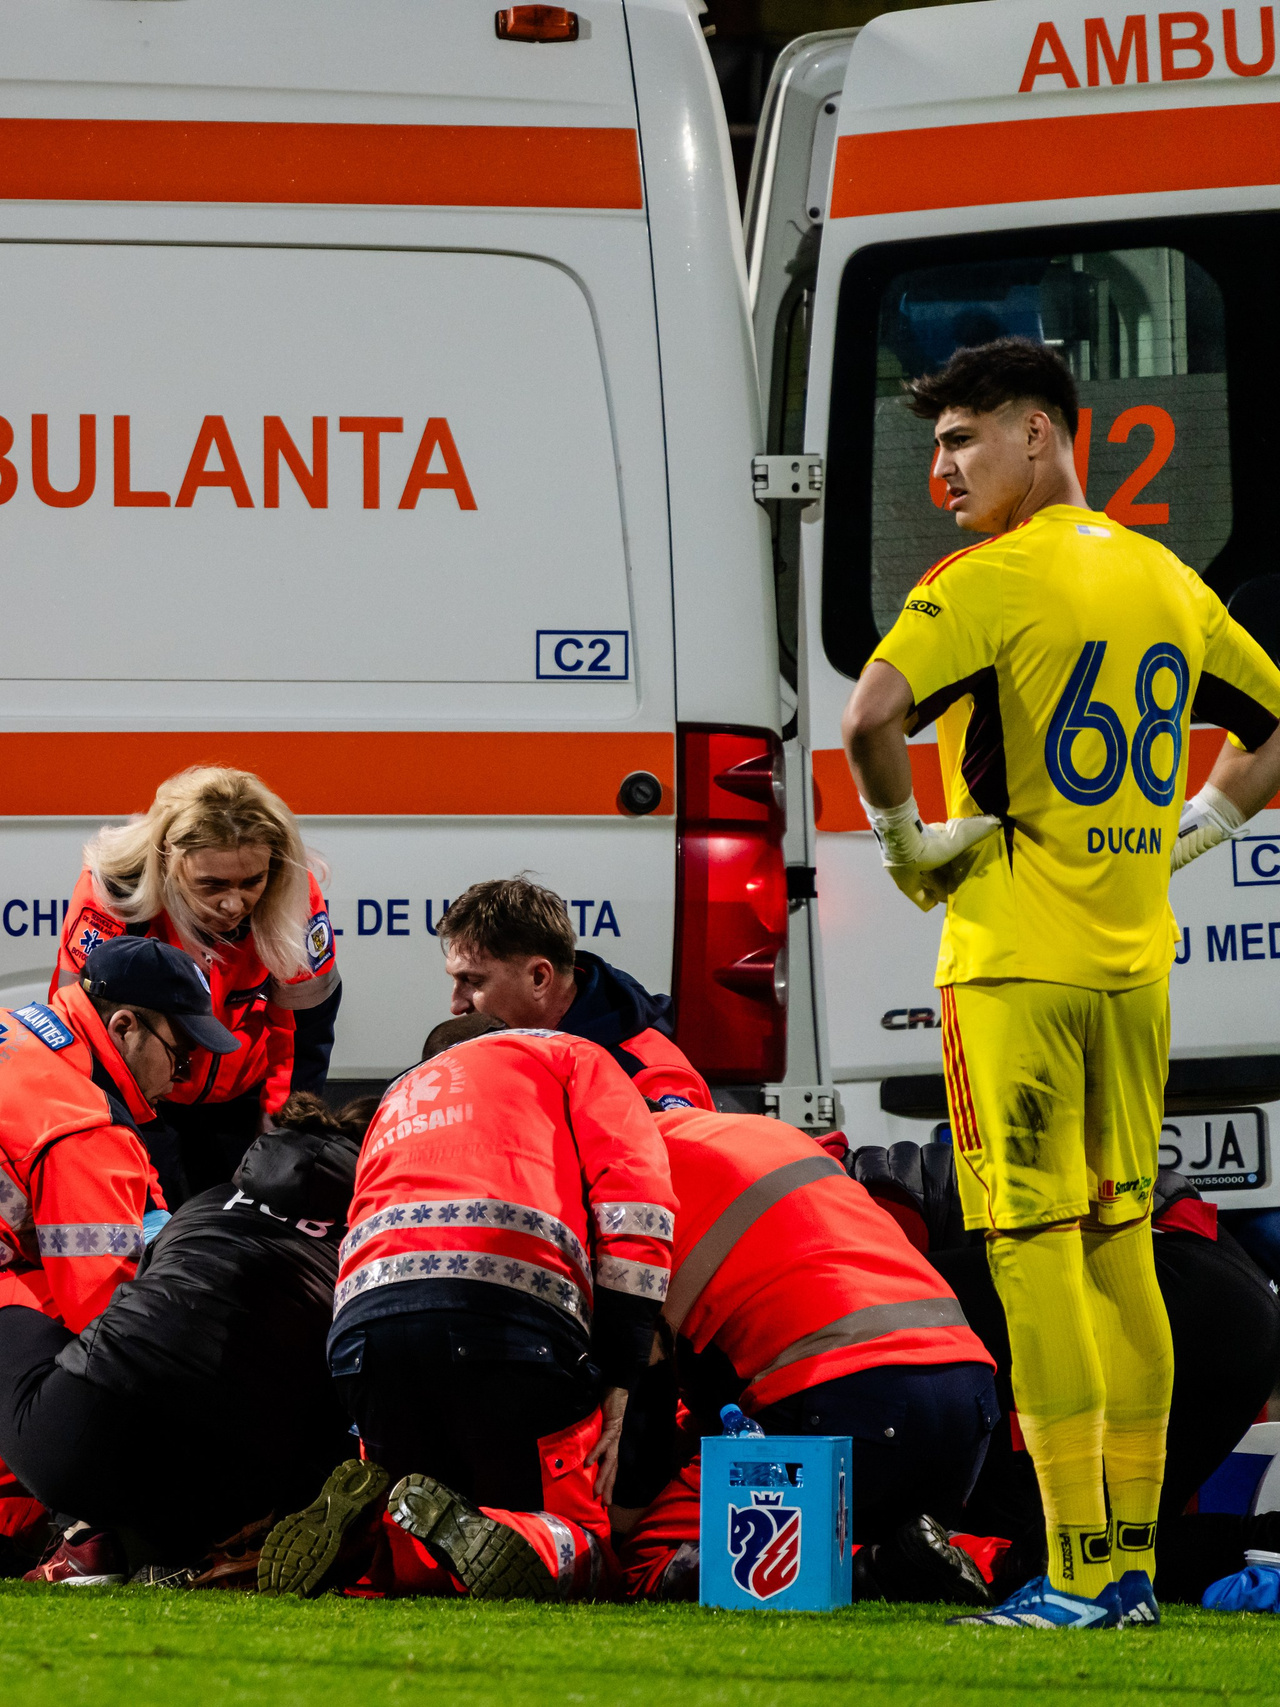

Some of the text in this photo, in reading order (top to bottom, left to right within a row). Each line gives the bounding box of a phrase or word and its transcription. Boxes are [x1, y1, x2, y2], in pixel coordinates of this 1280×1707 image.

[1018, 6, 1276, 93] AMBU
[552, 637, 612, 674] C2
[1044, 641, 1191, 807] 68
[1087, 826, 1162, 855] DUCAN
[357, 899, 410, 936] DE
[880, 1007, 942, 1031] CR
[363, 1102, 474, 1160] OTOSANI
